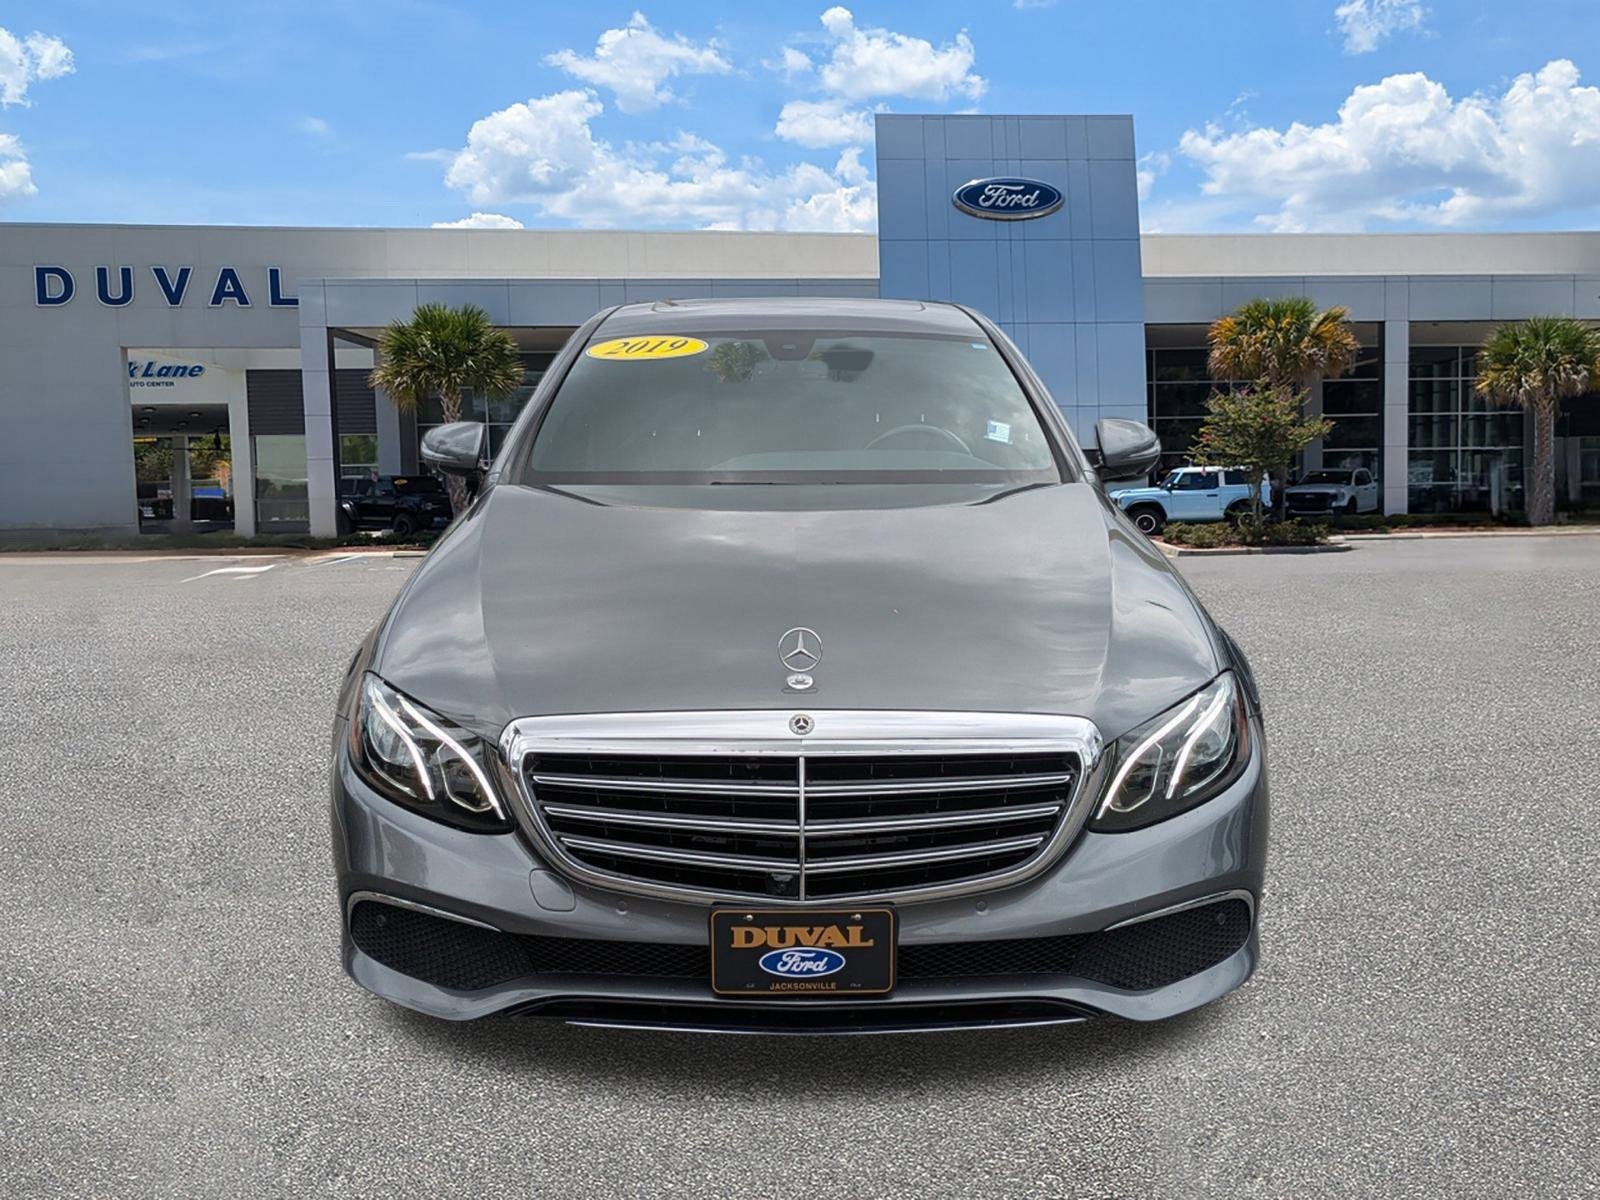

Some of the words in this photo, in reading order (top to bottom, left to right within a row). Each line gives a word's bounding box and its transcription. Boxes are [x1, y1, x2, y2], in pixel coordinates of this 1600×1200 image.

[979, 184, 1040, 207] Ford
[33, 265, 299, 308] DUVAL
[603, 339, 689, 355] 2019
[141, 361, 204, 378] Lane
[730, 925, 874, 948] DUVAL
[776, 951, 828, 973] Ford
[769, 982, 836, 990] JACKSONVILLE
